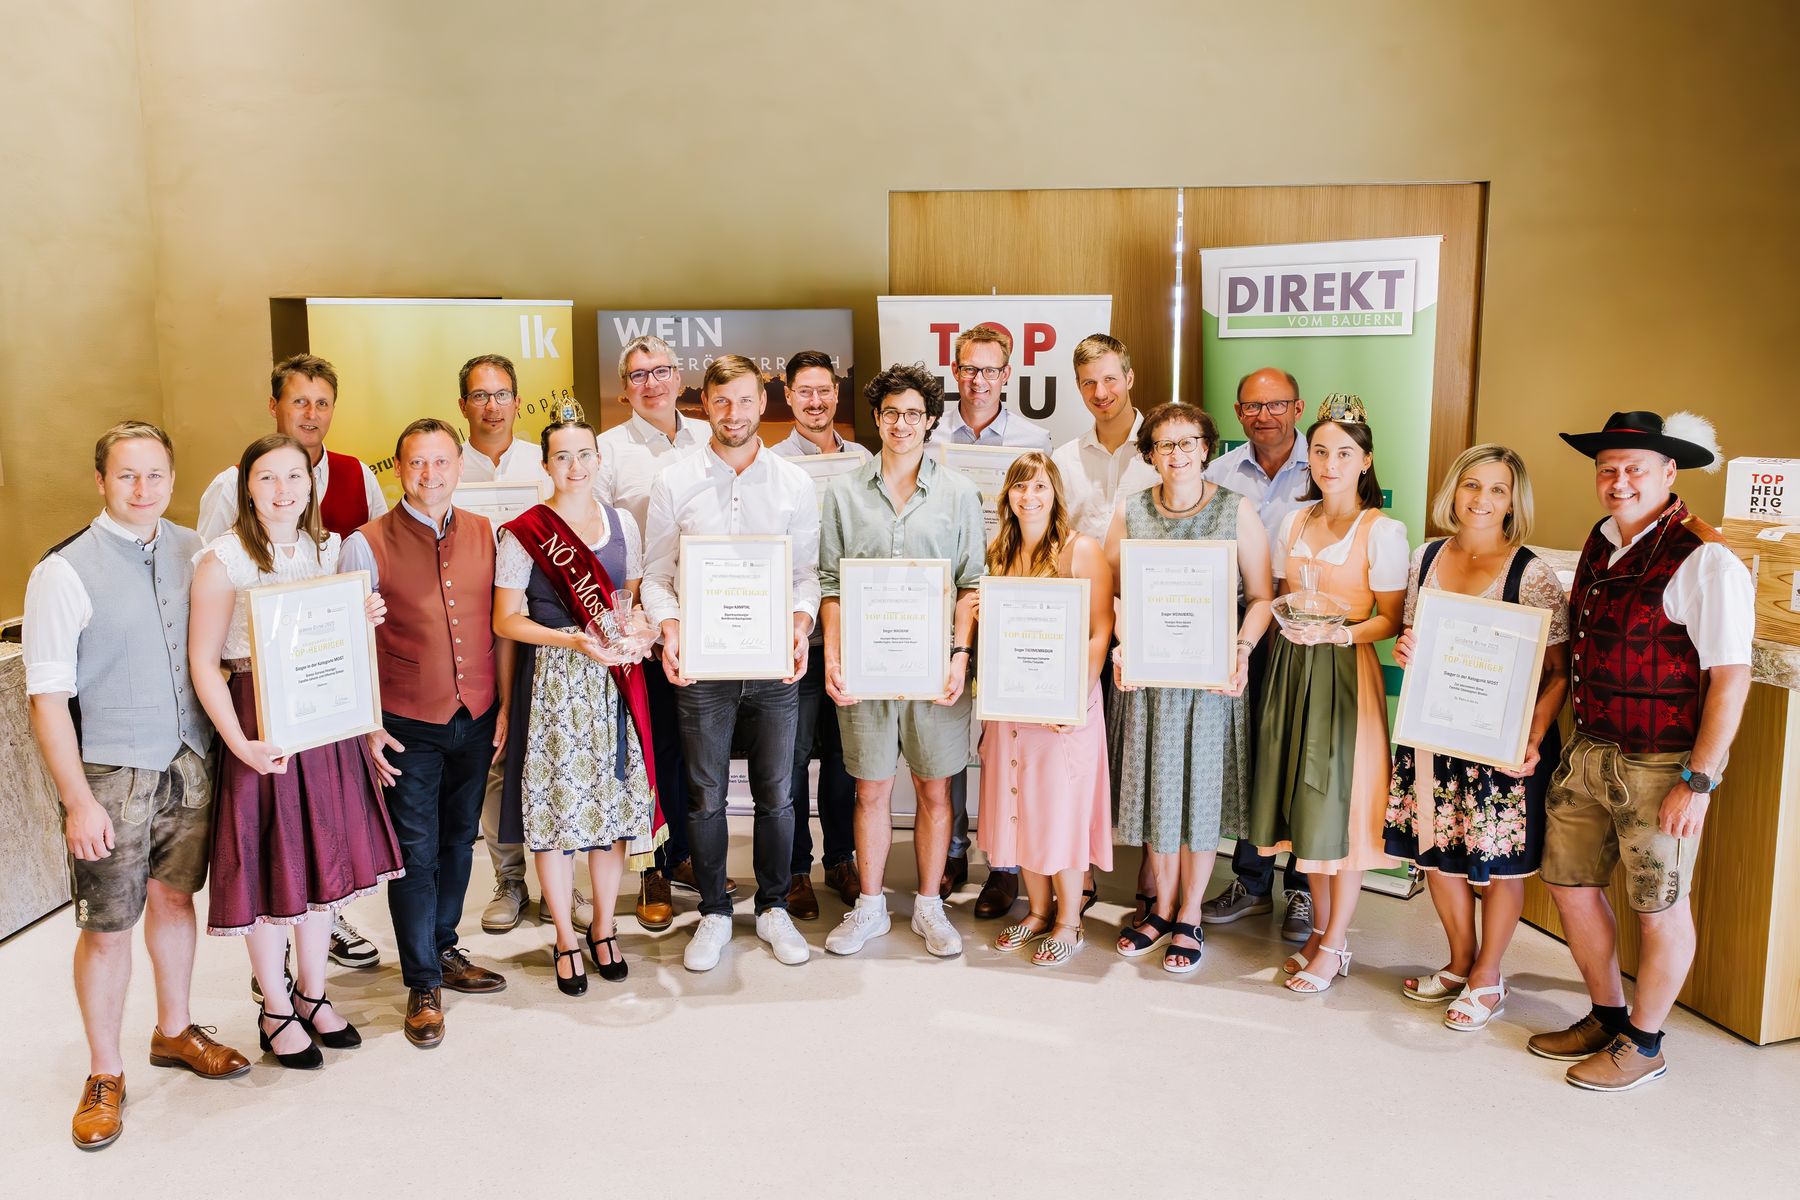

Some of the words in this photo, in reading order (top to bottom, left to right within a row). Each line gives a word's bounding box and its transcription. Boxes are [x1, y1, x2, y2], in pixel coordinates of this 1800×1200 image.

[1228, 270, 1405, 314] DIREKT
[1288, 316, 1323, 327] VOM
[1332, 314, 1395, 326] BAUERN
[613, 317, 722, 347] WEIN
[1751, 473, 1784, 485] TOP
[1751, 485, 1784, 496] HEU
[1750, 496, 1782, 508] RIG
[539, 532, 578, 567] NÖ
